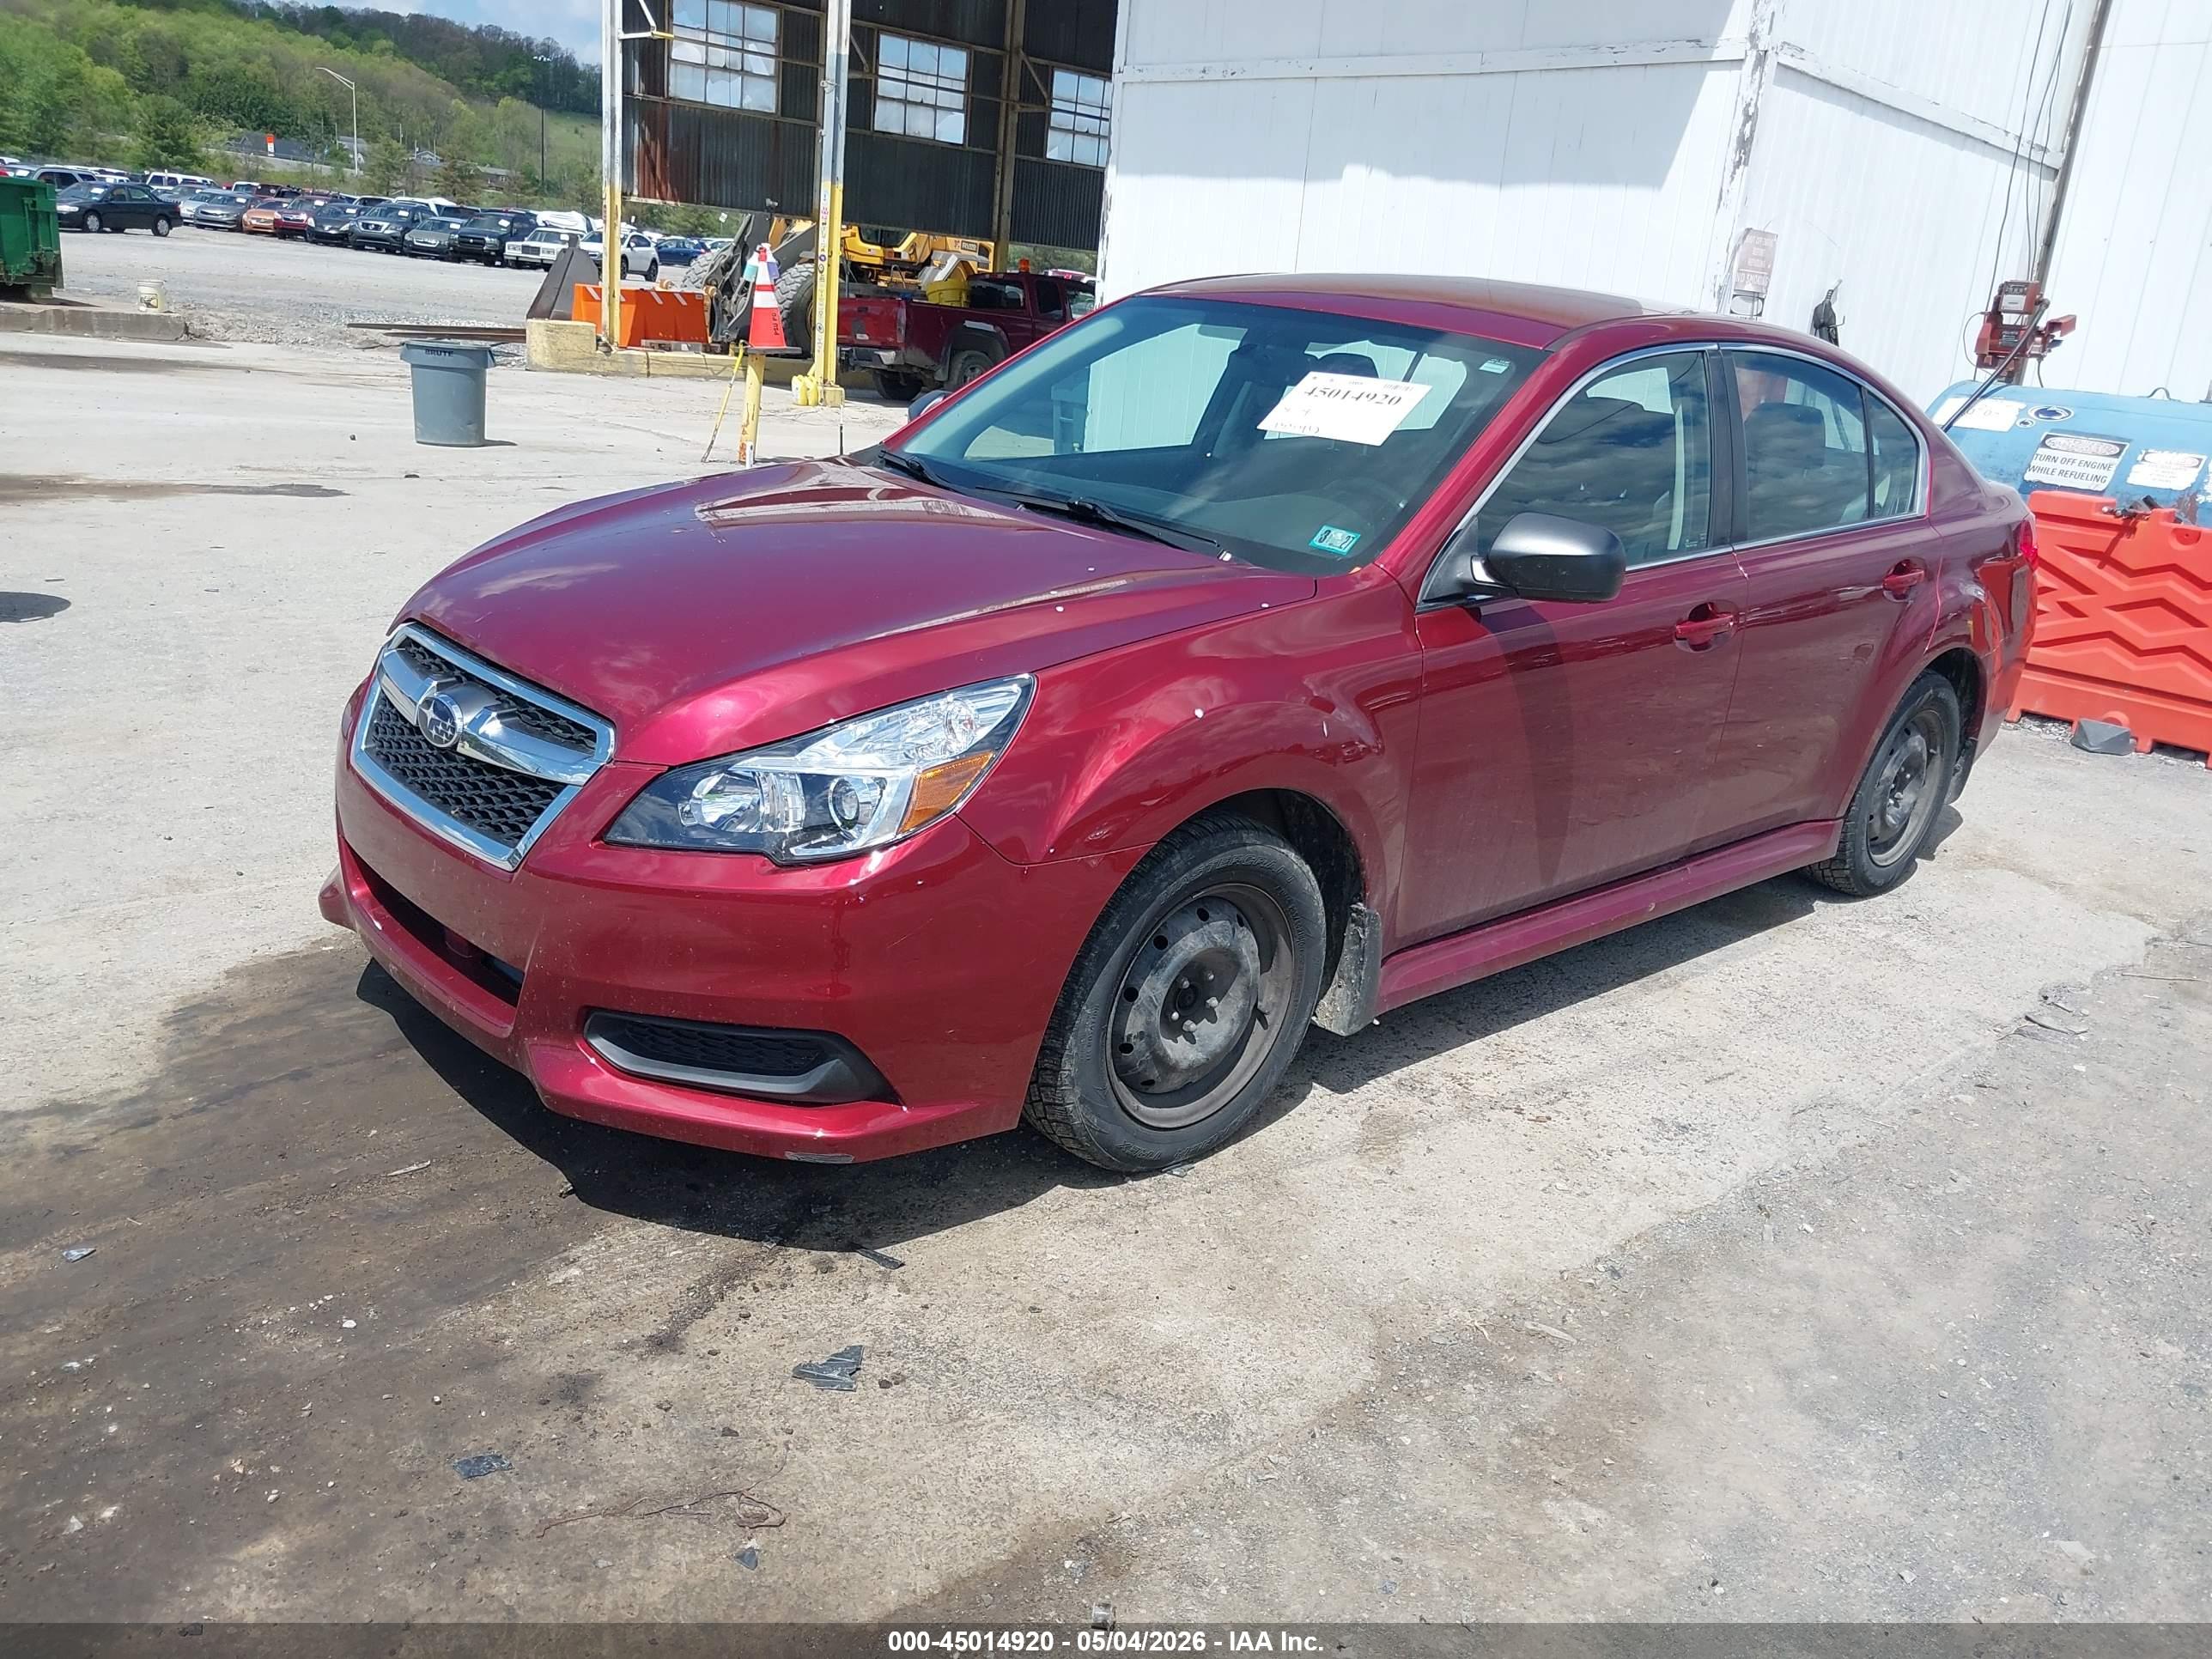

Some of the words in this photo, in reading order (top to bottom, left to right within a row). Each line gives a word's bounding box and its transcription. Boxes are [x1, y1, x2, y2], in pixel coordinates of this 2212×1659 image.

[1304, 386, 1402, 406] 45014920
[2034, 453, 2059, 464] TURN
[2061, 457, 2078, 466] OFF
[2079, 460, 2113, 471] ENGINE
[2028, 465, 2057, 477] WHILE
[2057, 469, 2108, 483] REFUELING
[1318, 529, 1331, 543] 3
